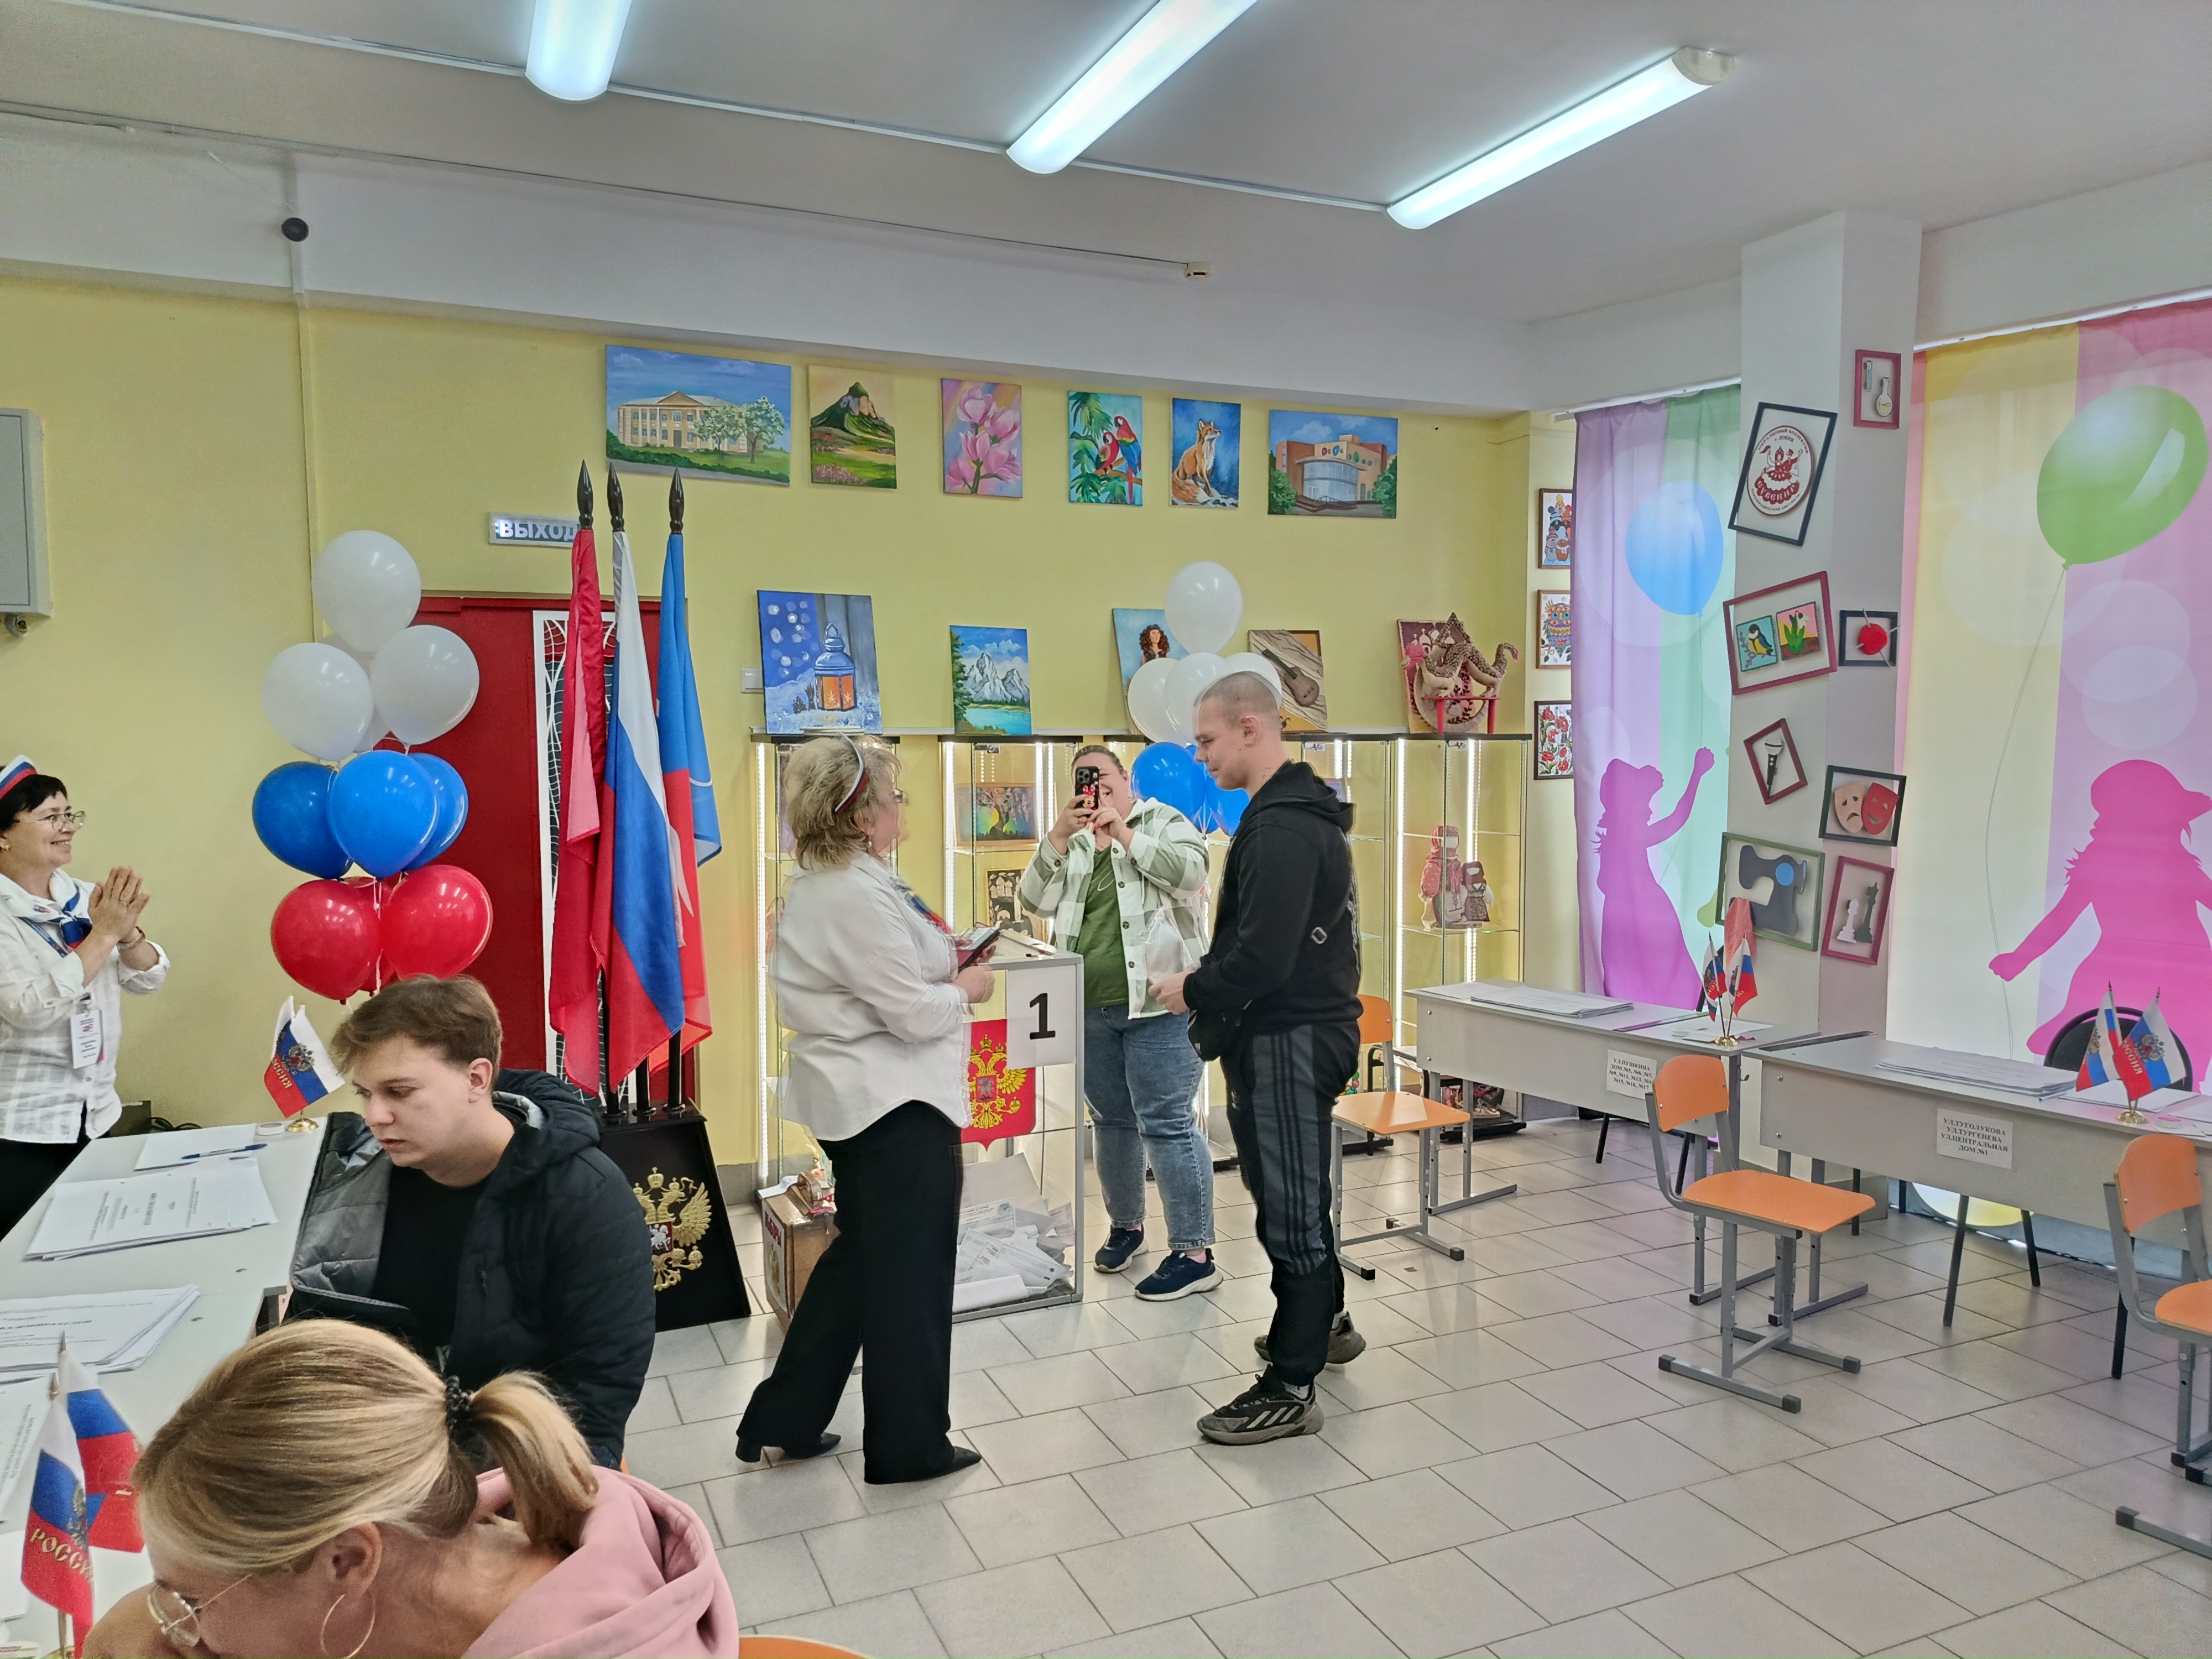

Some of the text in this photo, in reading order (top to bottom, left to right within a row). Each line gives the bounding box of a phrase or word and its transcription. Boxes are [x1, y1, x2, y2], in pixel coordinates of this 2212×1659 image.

[1757, 481, 1795, 500] СУВЕНИР
[499, 520, 577, 541] ВЫХОД
[1029, 993, 1055, 1040] 1
[1943, 1118, 2006, 1136] УЛ.ТУГОЛУКОВА
[1947, 1126, 2002, 1143] УЛ.ТУРГЕНЕВА
[1940, 1133, 2008, 1152] УЛ.ЦЕНТРАЛЬНАЯ
[1958, 1145, 1976, 1153] ДОМ
[30, 1528, 93, 1580] РОССИ
